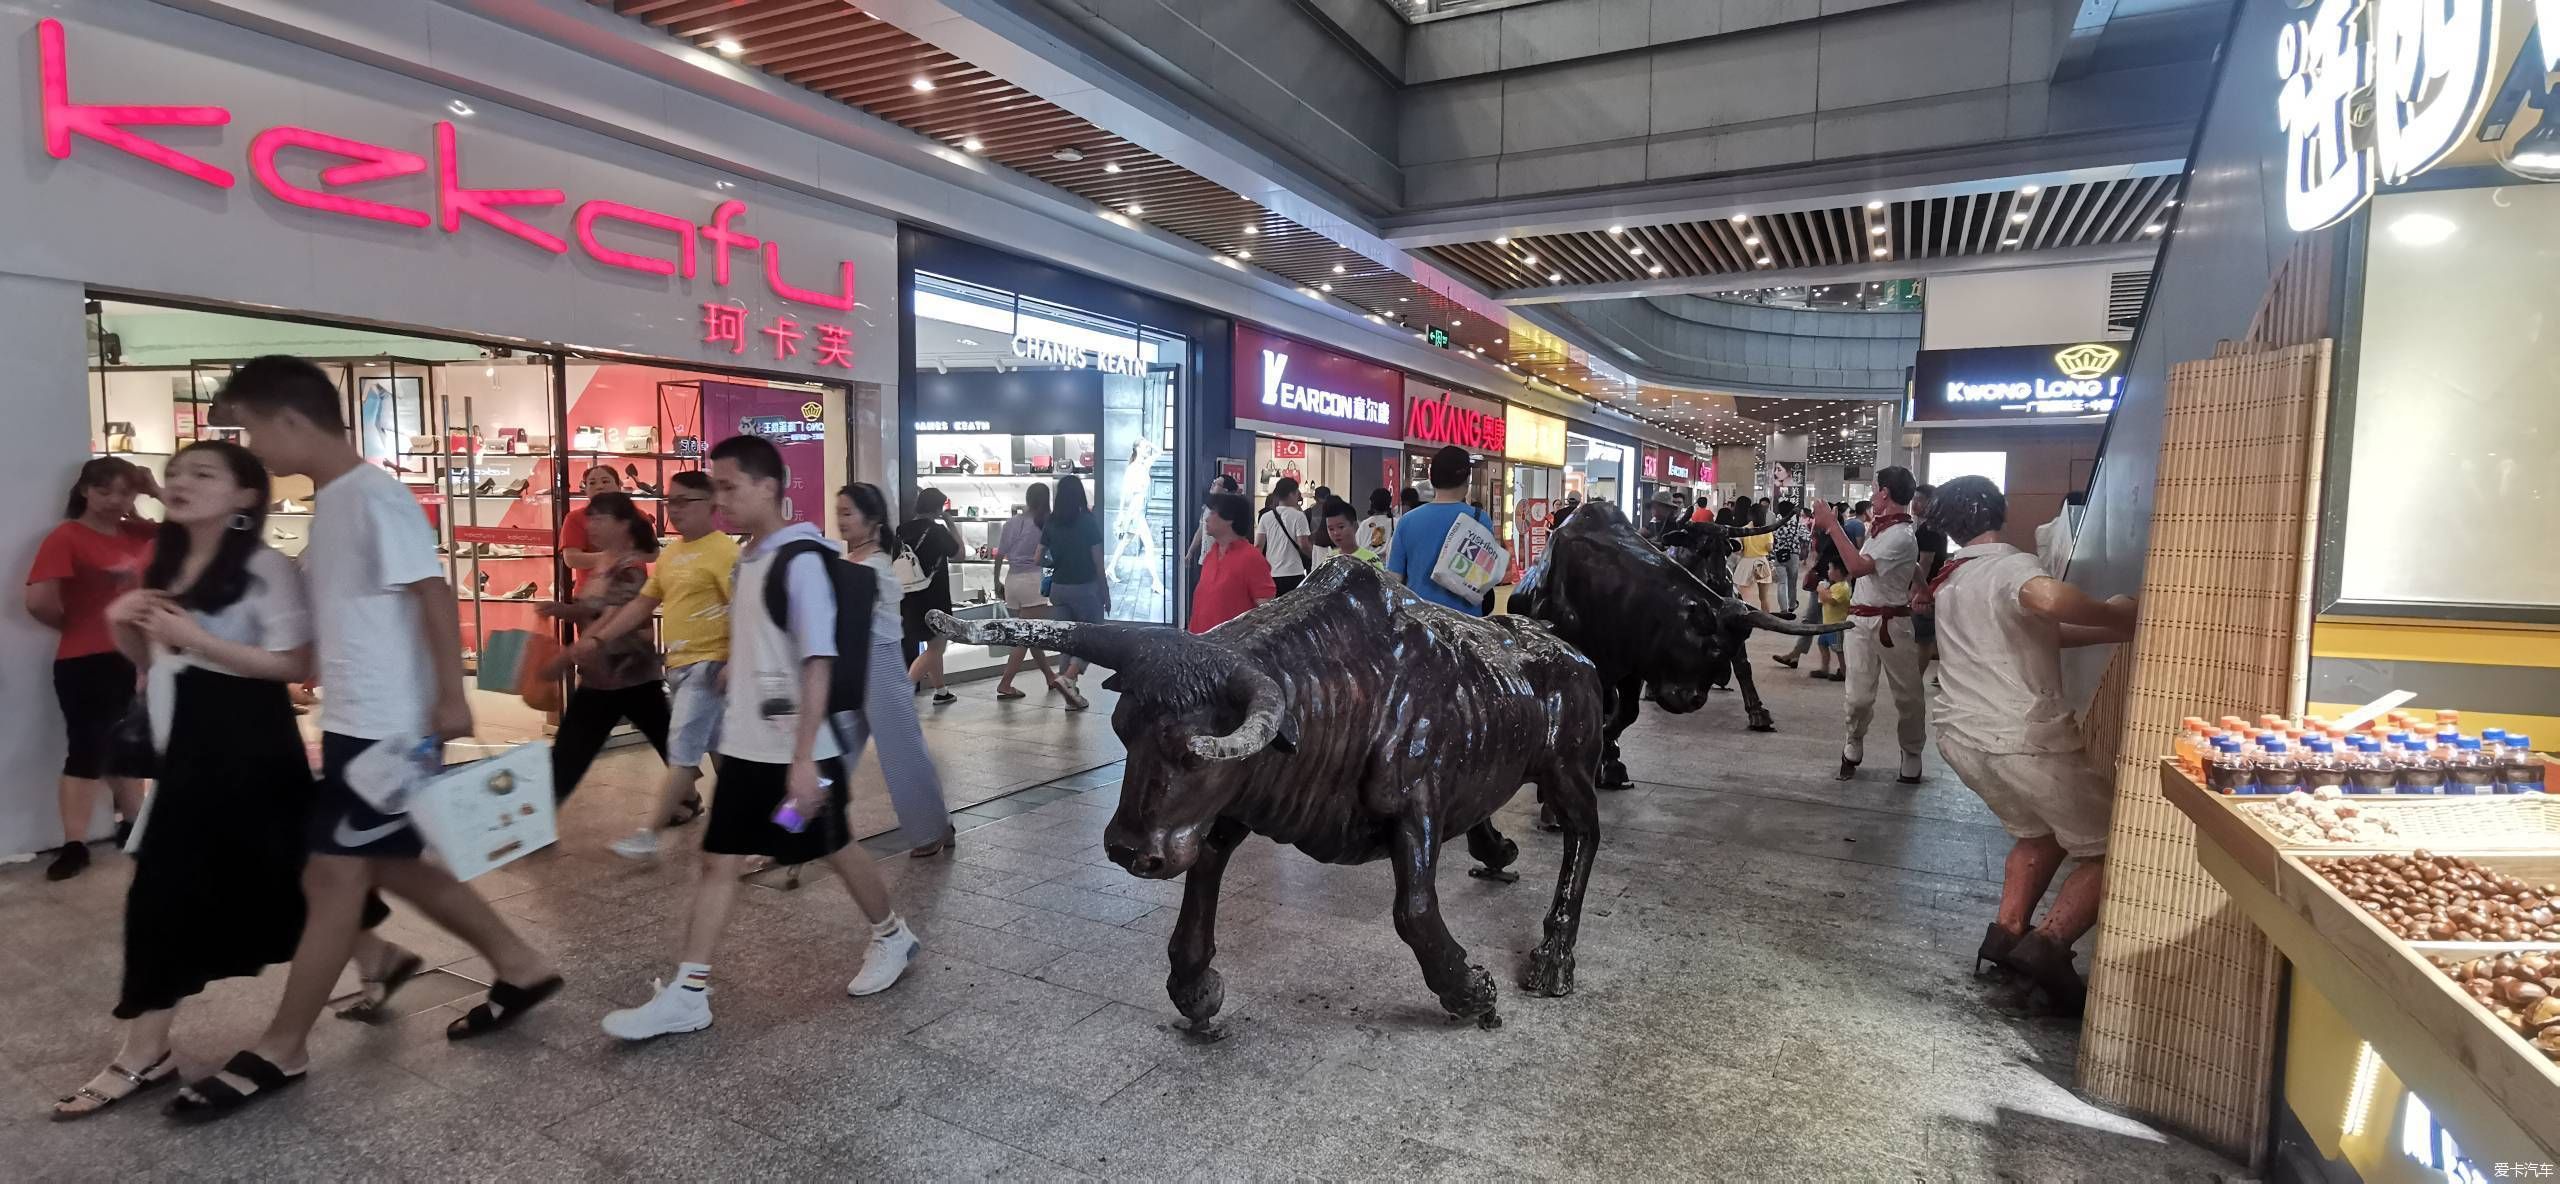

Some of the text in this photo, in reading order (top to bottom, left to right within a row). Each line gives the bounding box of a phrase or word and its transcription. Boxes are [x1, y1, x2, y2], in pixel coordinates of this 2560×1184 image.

[37, 18, 856, 312] kekafu
[703, 302, 854, 369] 珂卡芙
[1261, 349, 1352, 420] YEARCON
[1946, 382, 2032, 402] KWONG
[2035, 377, 2103, 399] LONG
[1481, 413, 1506, 452] 奥康
